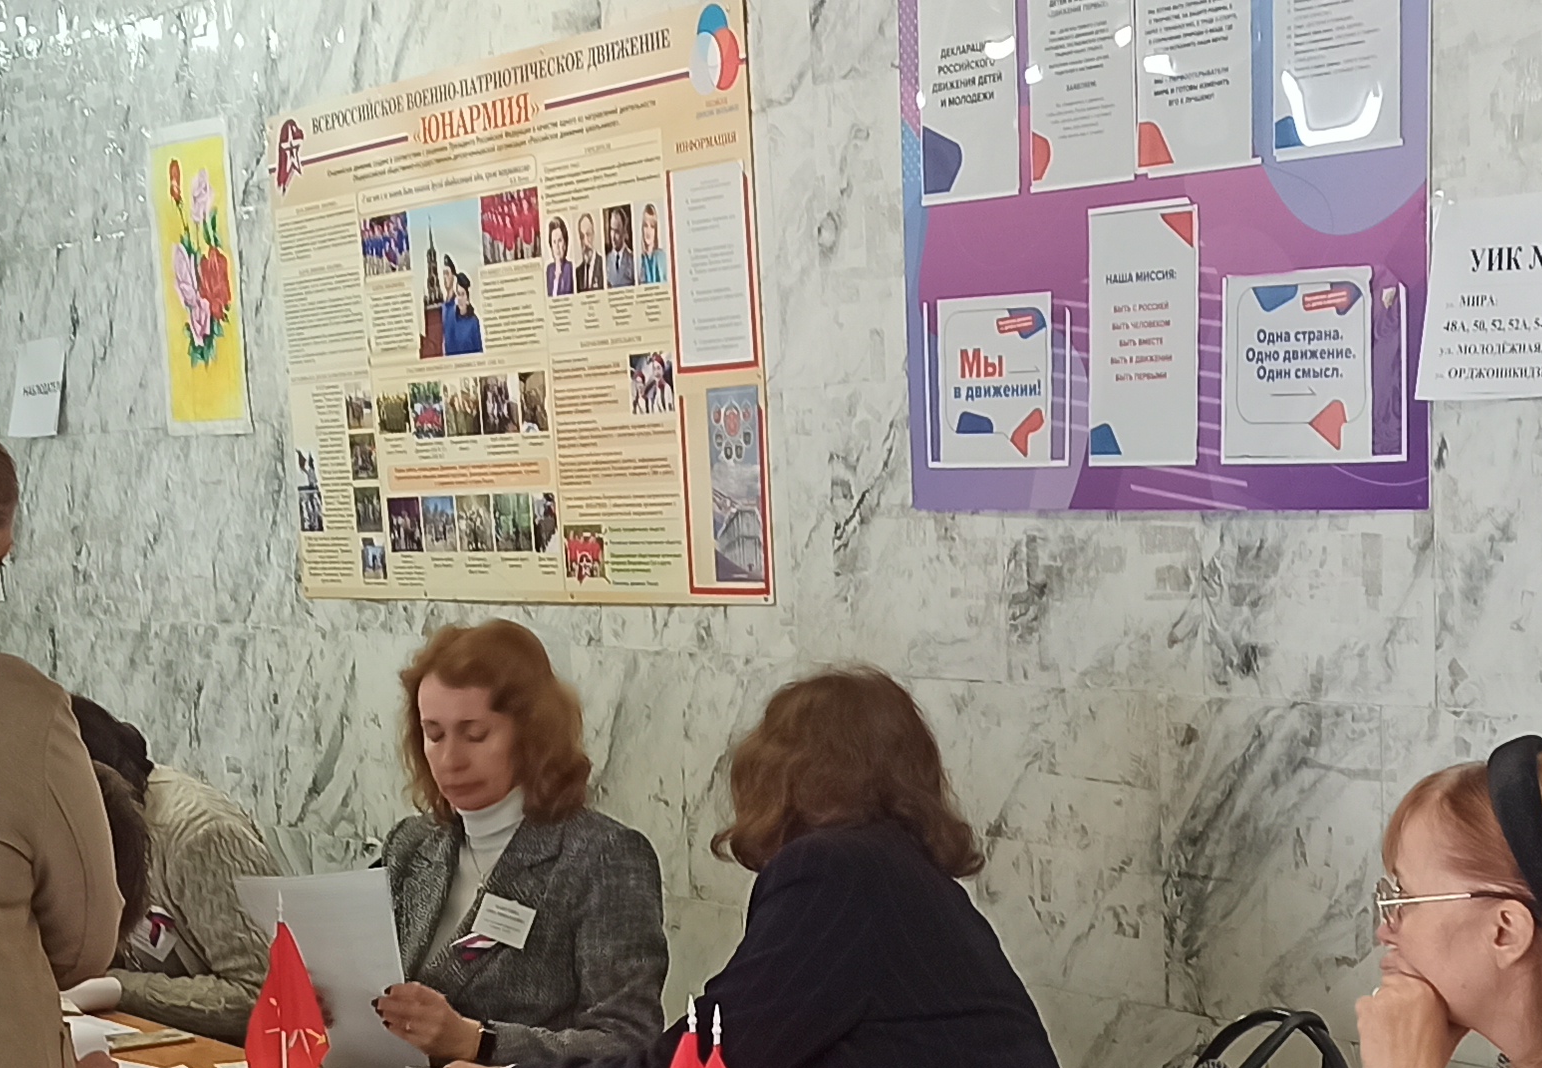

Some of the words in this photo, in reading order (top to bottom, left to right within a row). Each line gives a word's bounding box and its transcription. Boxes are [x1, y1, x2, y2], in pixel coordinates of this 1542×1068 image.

[940, 40, 991, 60] ДЕКЛАРАЦИ
[311, 94, 404, 135] ВСЕРОССИЙСКОЕ
[587, 28, 671, 73] ДВИЖЕНИЕ
[977, 71, 1003, 87] ДЕТЕЙ
[413, 92, 540, 145] «ЮНАРМИЯ»
[676, 131, 737, 154] ИНФОРМАЦИЯ
[1470, 246, 1523, 272] УИК
[1105, 272, 1134, 285] НАША
[1136, 269, 1177, 283] МИССИЯ:
[1256, 328, 1291, 346] Одна
[1294, 328, 1344, 345] страна.
[960, 347, 1003, 379] Мы
[1245, 346, 1280, 364] Одно
[1283, 347, 1356, 364] движение.
[1256, 365, 1291, 382] Один
[1294, 366, 1344, 379] смысл.
[953, 386, 962, 399] в
[965, 378, 1041, 402] движении!
